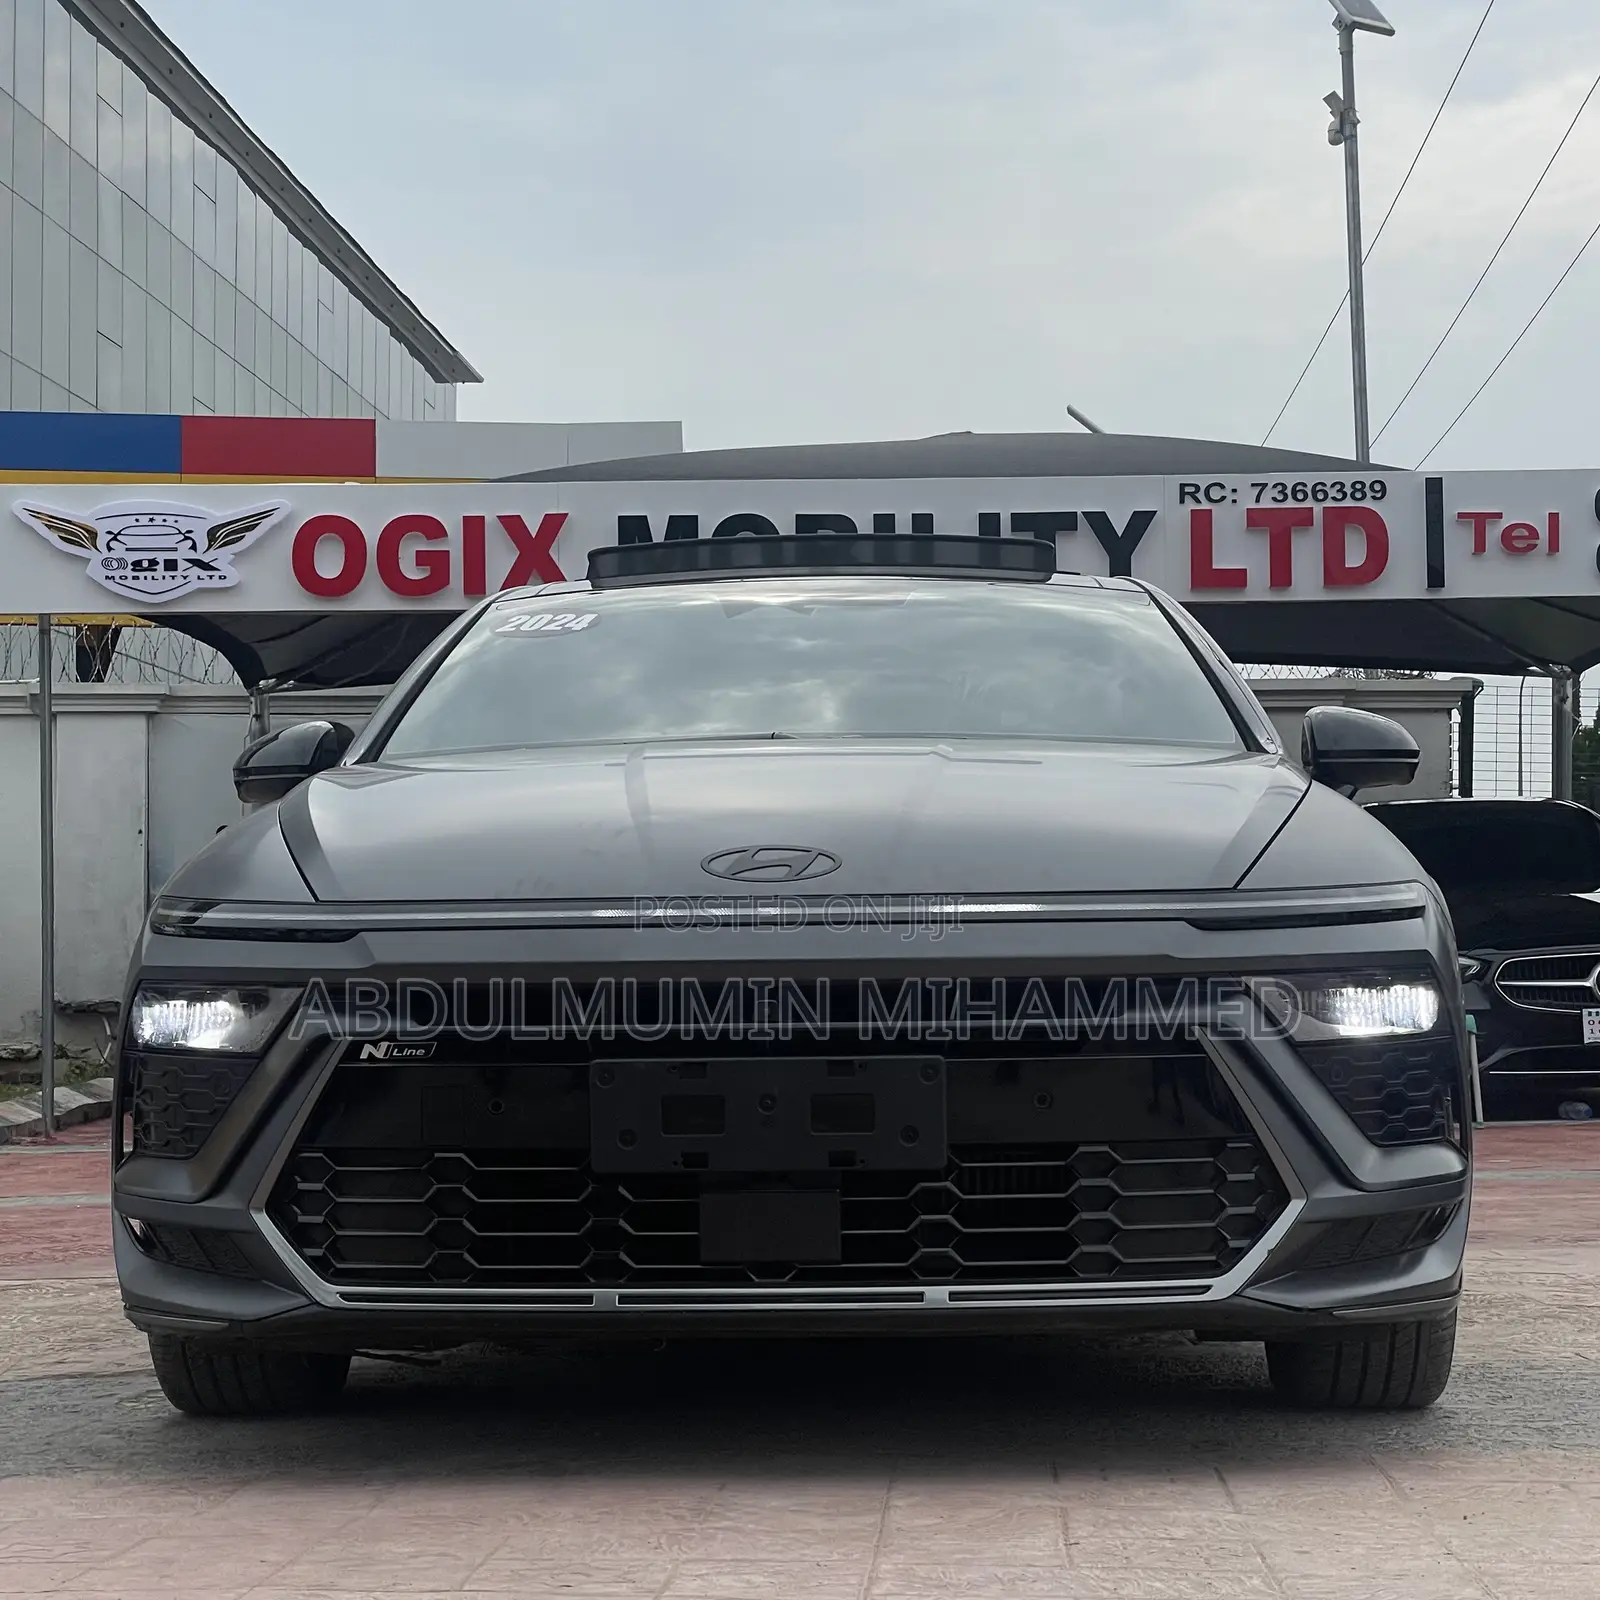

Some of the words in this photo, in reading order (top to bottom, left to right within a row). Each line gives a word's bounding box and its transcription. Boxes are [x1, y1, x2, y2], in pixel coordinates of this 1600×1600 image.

[1179, 482, 1238, 504] RC:
[1250, 480, 1388, 503] 7366389
[1456, 511, 1560, 555] Tel
[291, 513, 569, 597] OGIX
[1190, 506, 1390, 588] LTD
[495, 613, 598, 632] 2024
[393, 1048, 425, 1056] Line
